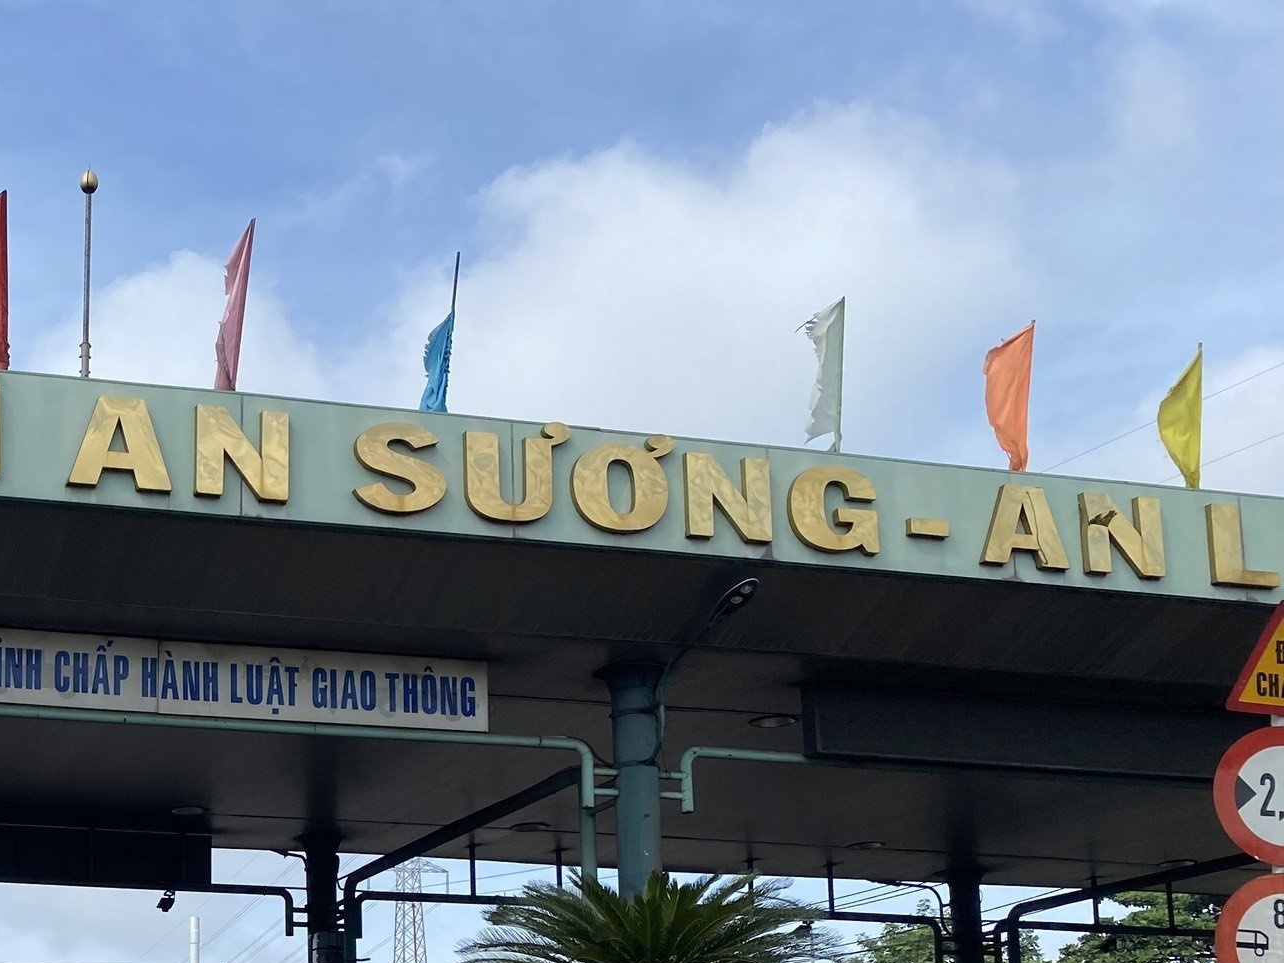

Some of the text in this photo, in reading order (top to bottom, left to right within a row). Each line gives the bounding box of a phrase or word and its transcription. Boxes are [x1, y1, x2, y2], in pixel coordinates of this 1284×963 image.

[66, 396, 291, 505] AN
[979, 484, 1166, 580] AN
[54, 640, 129, 696] CHẤP
[141, 649, 219, 703] HÀNH
[230, 656, 299, 715] LUẬT
[312, 666, 377, 711] GIAO
[385, 665, 476, 717] THÔNG
